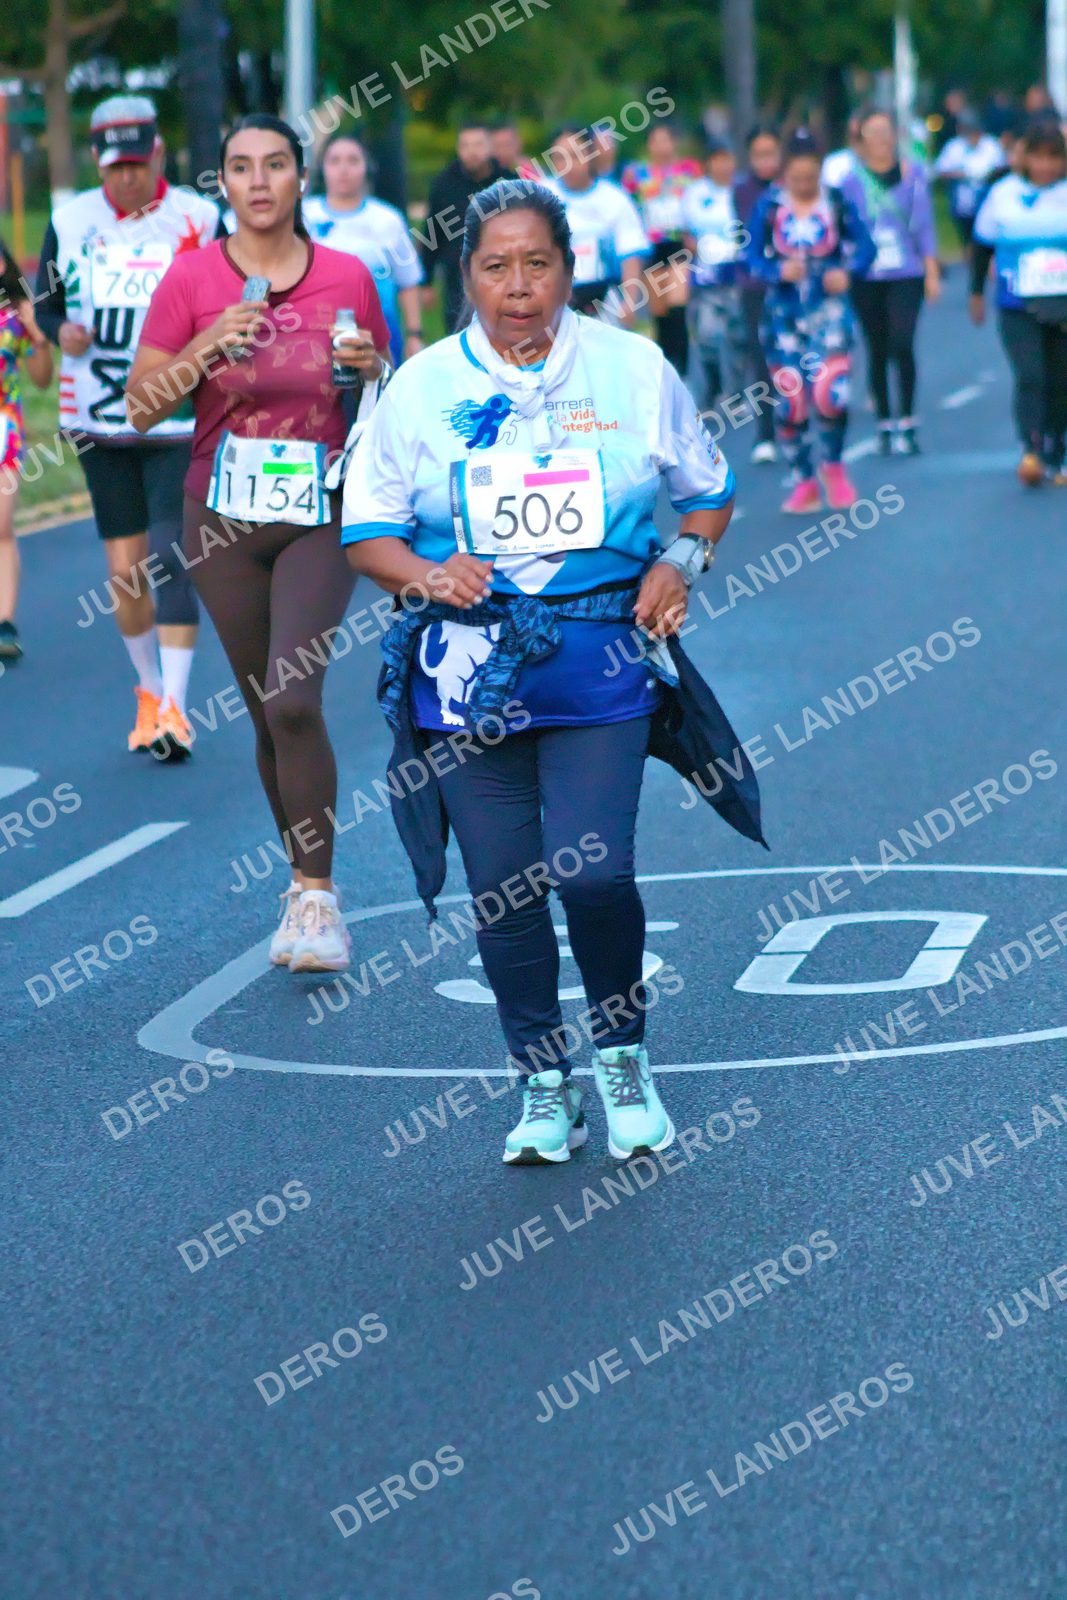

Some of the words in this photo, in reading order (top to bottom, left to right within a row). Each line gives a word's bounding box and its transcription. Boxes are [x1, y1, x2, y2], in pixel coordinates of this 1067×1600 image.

[105, 270, 160, 299] 760
[570, 408, 597, 421] Vida
[226, 470, 315, 514] 1154
[491, 490, 583, 540] 506
